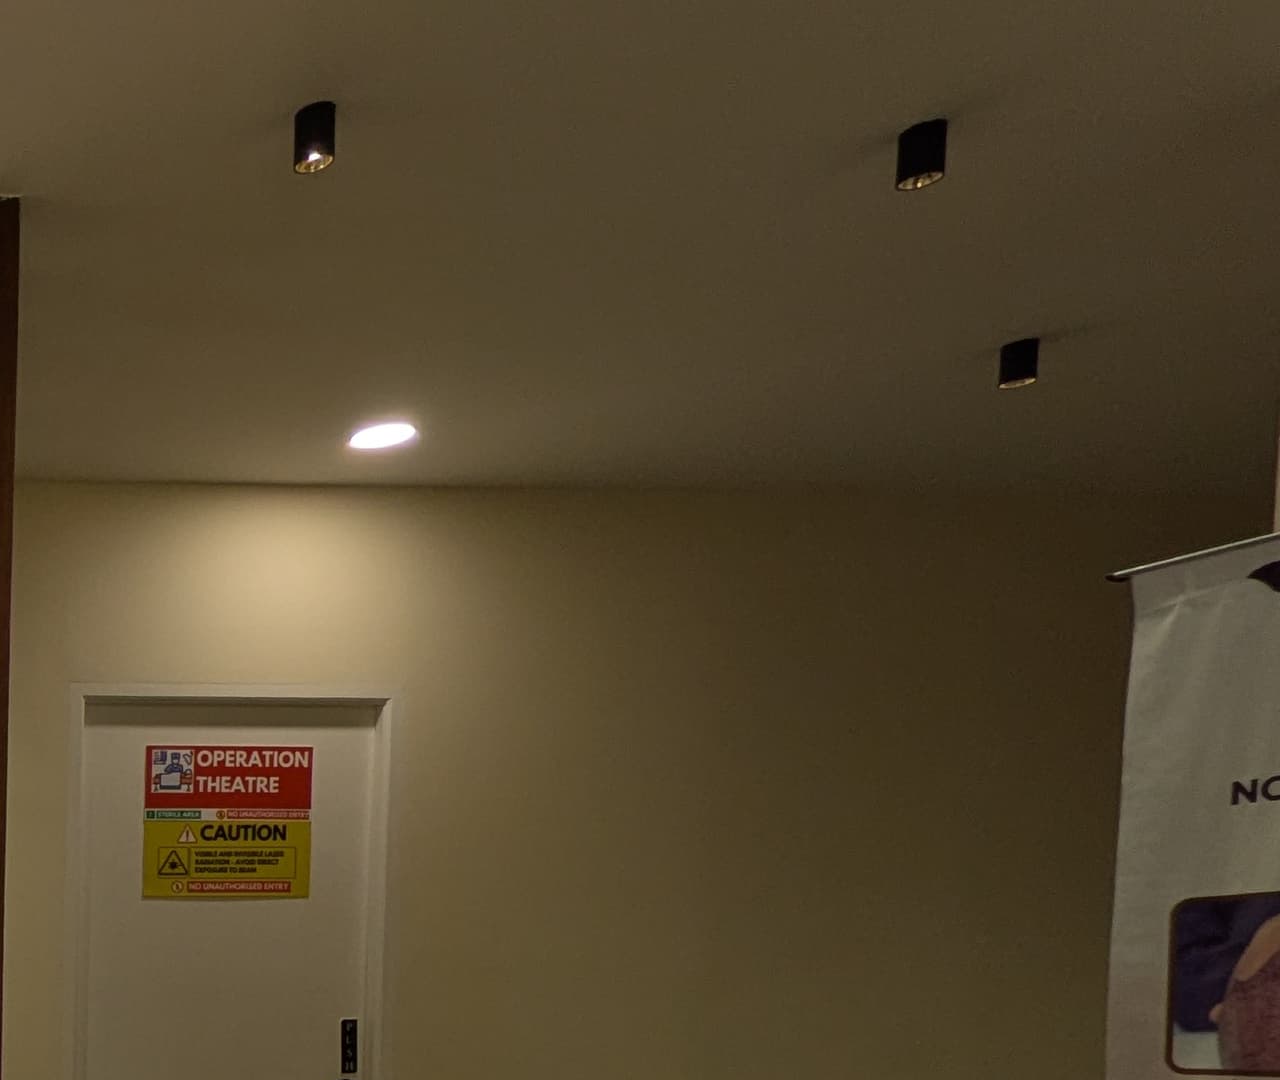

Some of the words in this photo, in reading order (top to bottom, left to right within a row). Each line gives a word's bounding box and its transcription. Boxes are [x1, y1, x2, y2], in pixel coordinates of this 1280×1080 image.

[196, 750, 309, 768] OPERATION
[196, 776, 279, 793] THEATRE
[200, 824, 287, 842] CAUTION
